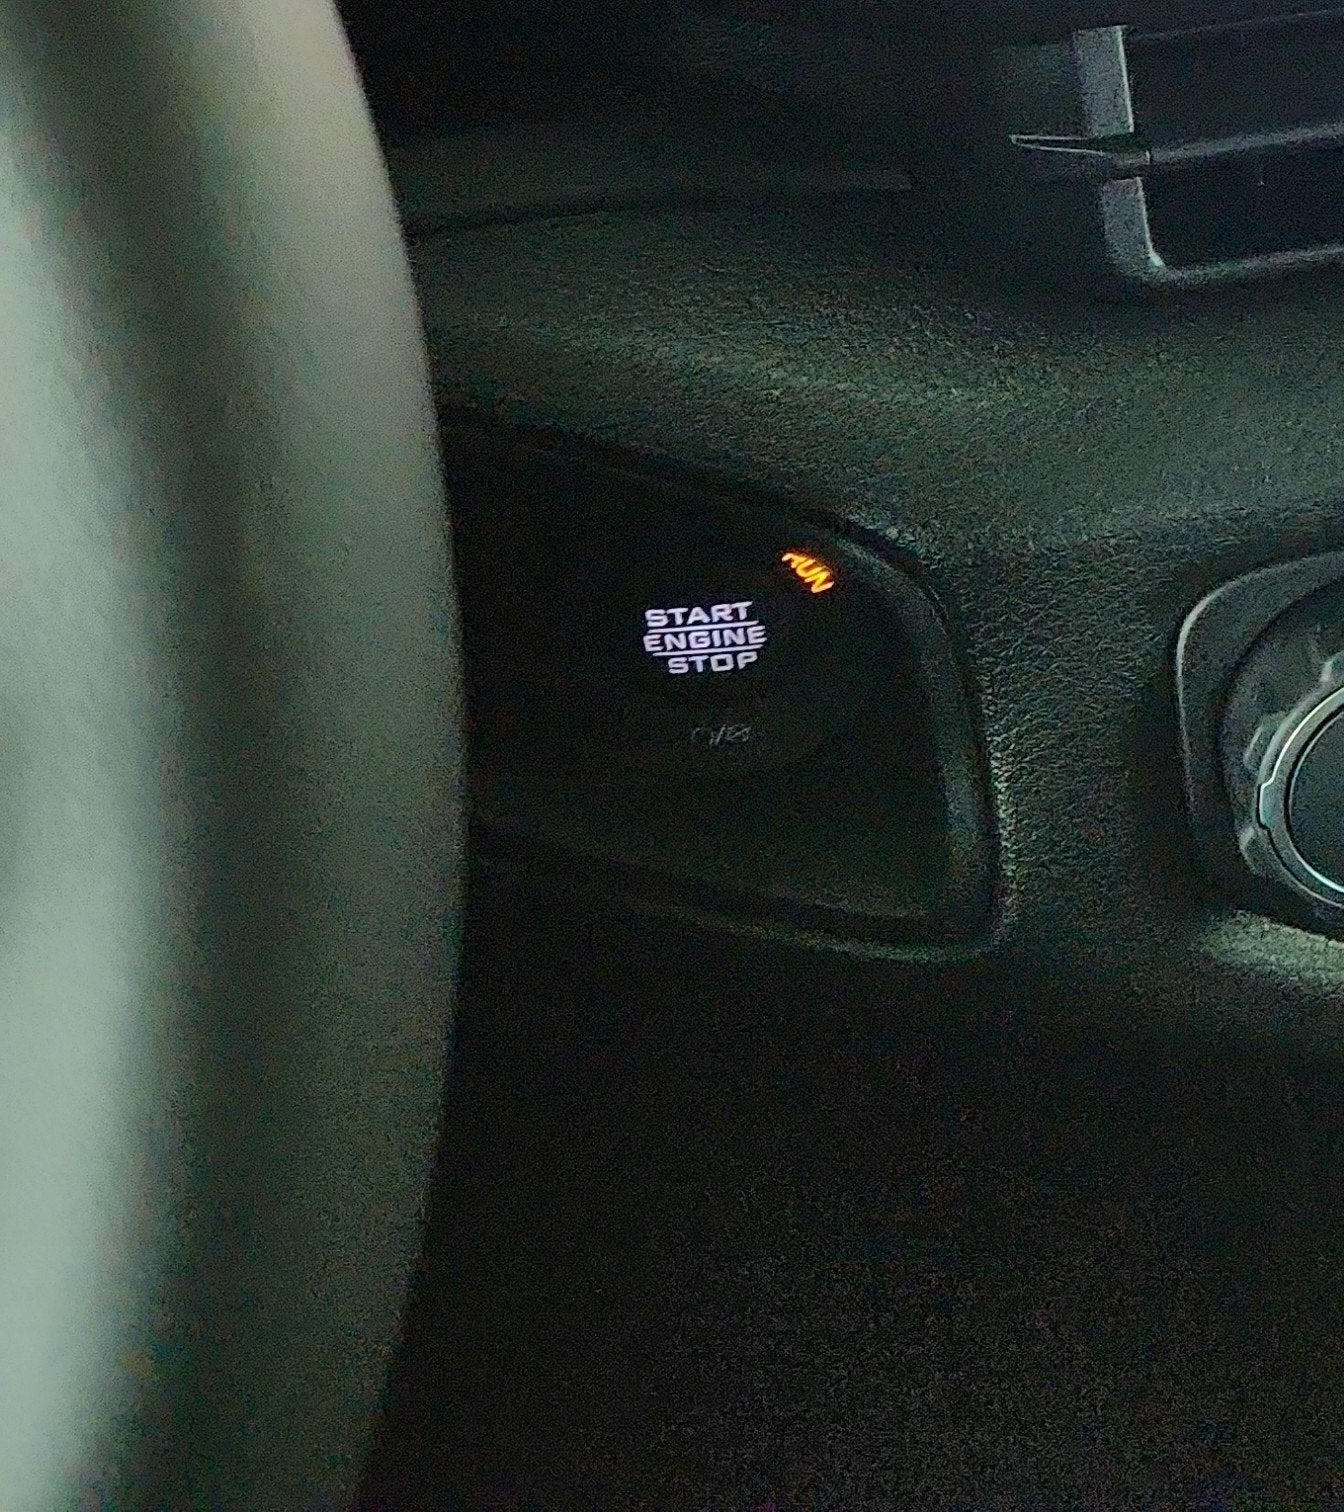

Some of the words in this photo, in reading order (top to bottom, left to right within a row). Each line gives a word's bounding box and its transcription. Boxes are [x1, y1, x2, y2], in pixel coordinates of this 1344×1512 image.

[644, 600, 753, 628] START
[643, 625, 768, 652] ENGINE
[667, 651, 758, 675] STOP
